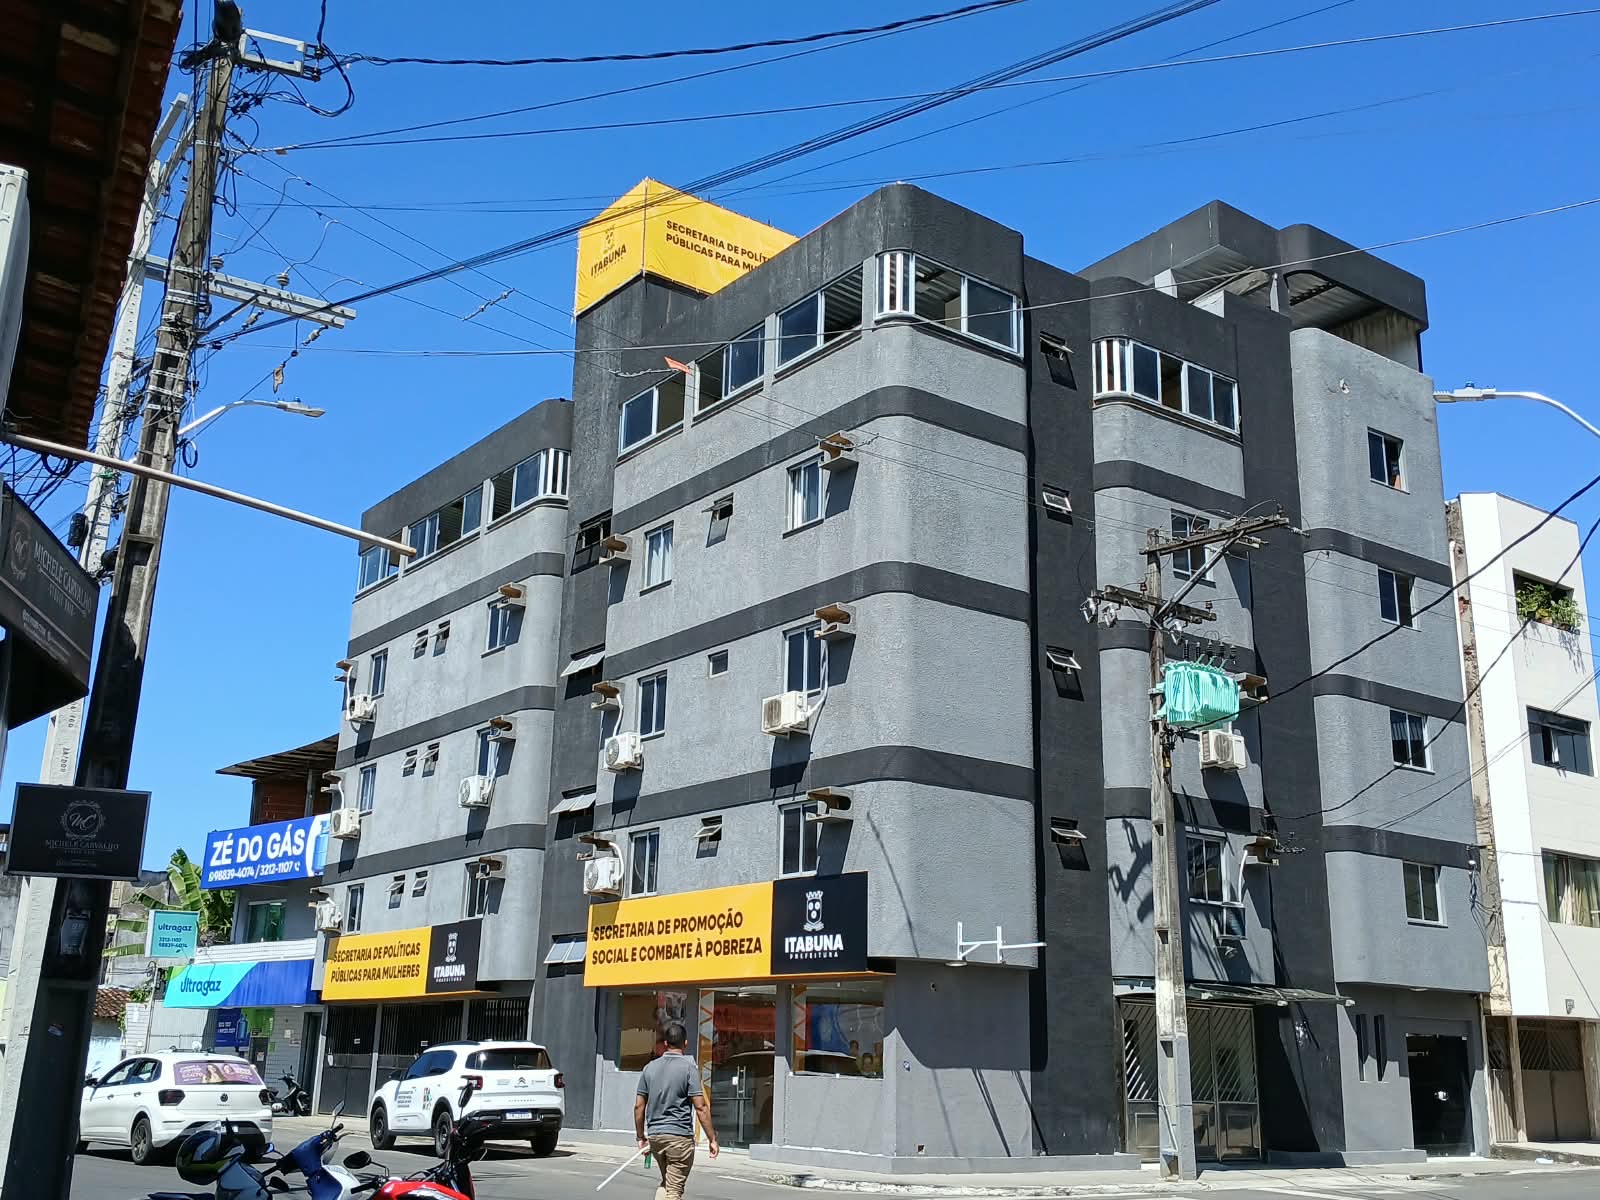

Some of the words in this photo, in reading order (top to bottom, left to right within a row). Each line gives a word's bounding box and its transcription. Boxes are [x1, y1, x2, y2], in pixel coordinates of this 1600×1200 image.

[666, 220, 725, 249] SECRETARIA
[727, 243, 739, 254] DE
[741, 248, 769, 263] POLÍT
[666, 233, 713, 258] PÚBLICAS
[715, 251, 741, 268] PARA
[590, 243, 627, 277] ITABUNA
[33, 540, 63, 584] MICHELE
[209, 833, 234, 867] ZÉ
[236, 835, 263, 863] DO
[266, 824, 305, 859] GÁS
[260, 861, 294, 876] 3212-1107
[158, 923, 192, 933] ultragaz
[592, 921, 655, 941] SECRETARIA
[657, 919, 671, 935] DE
[673, 908, 743, 935] PROMOÇÃO
[333, 946, 372, 963] SECRETARIA
[373, 947, 382, 959] DE
[383, 941, 421, 959] POLÍTICAS
[592, 948, 629, 965] SOCIAL
[631, 947, 637, 962] E
[639, 942, 693, 961] COMBATE
[694, 937, 703, 958] À
[705, 936, 762, 957] POBREZA
[784, 933, 844, 953] ITABUNA
[789, 951, 839, 960] PREFEITURA
[330, 967, 362, 983] PÚBLICAS
[363, 967, 381, 981] PARA
[382, 964, 420, 979] MULHERES
[433, 964, 466, 978] ITABUNA
[180, 976, 221, 996] ultragaz
